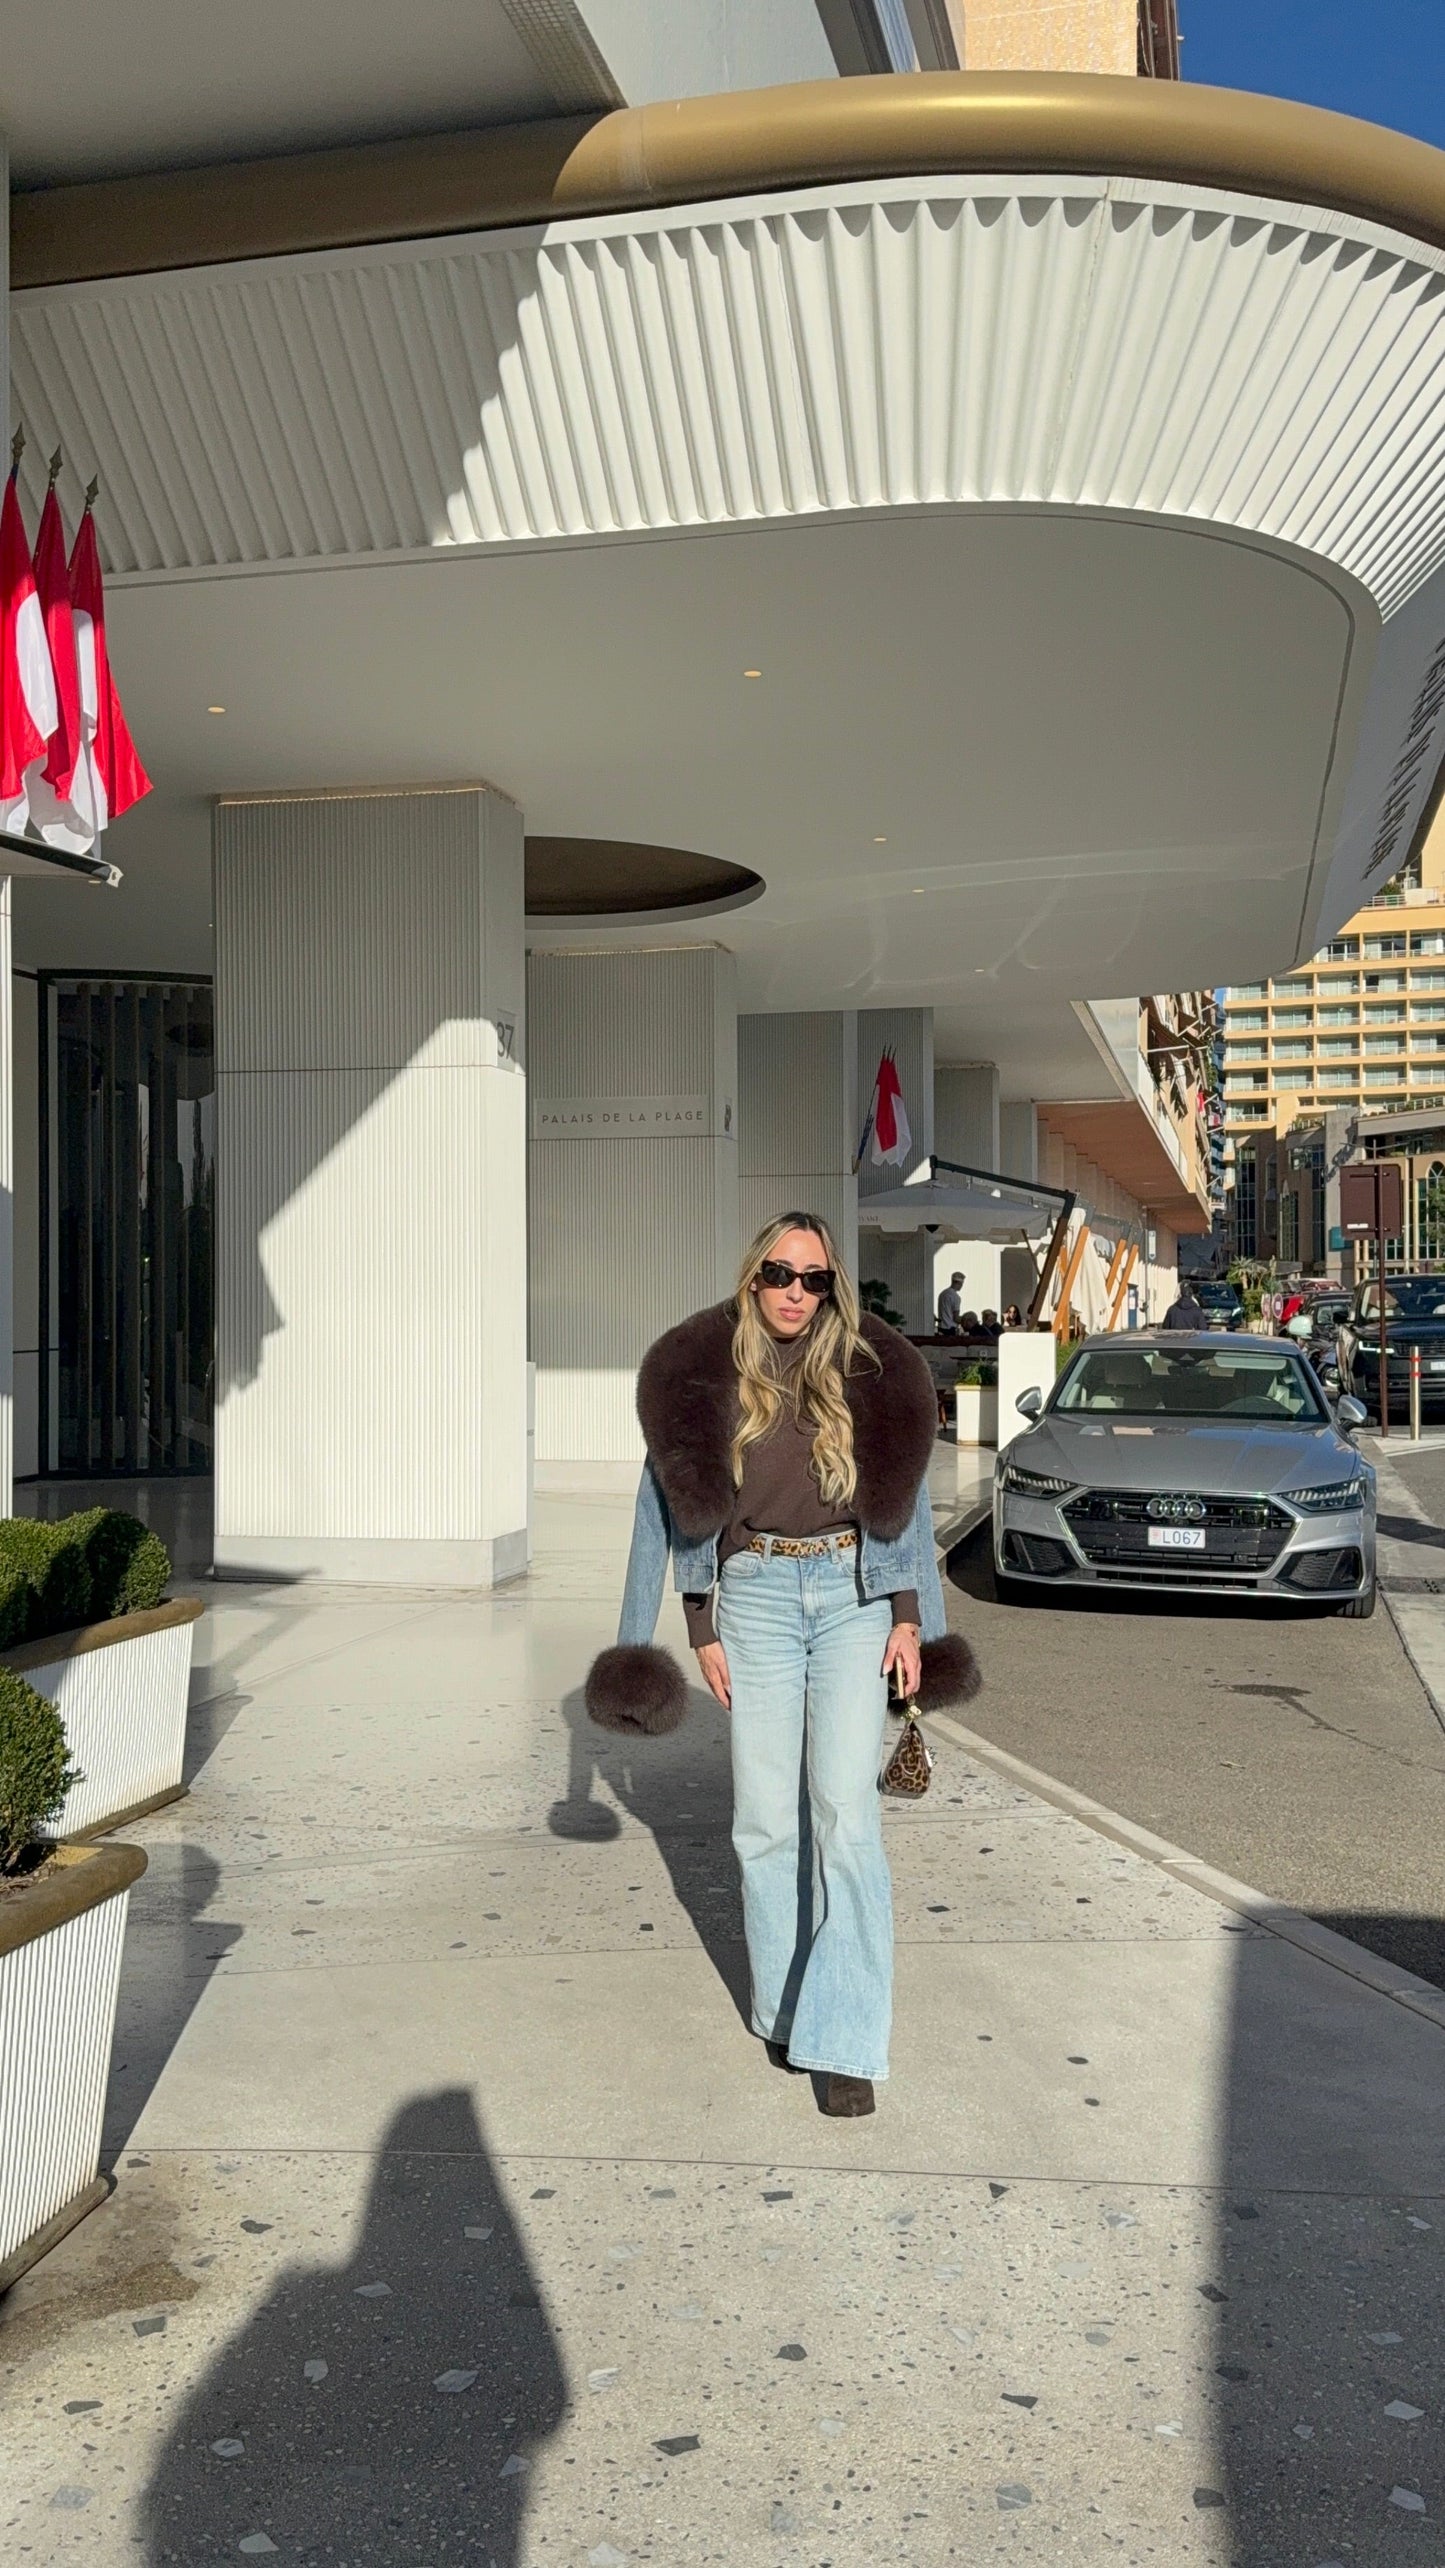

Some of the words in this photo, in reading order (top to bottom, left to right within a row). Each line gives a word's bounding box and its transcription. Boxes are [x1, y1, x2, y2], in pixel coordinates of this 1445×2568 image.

[497, 1022, 515, 1059] 37
[542, 1113, 593, 1124] PALAIS
[602, 1113, 620, 1123] DE
[629, 1112, 647, 1122] LA
[655, 1110, 704, 1121] PLAGE
[1162, 1530, 1201, 1545] L067
